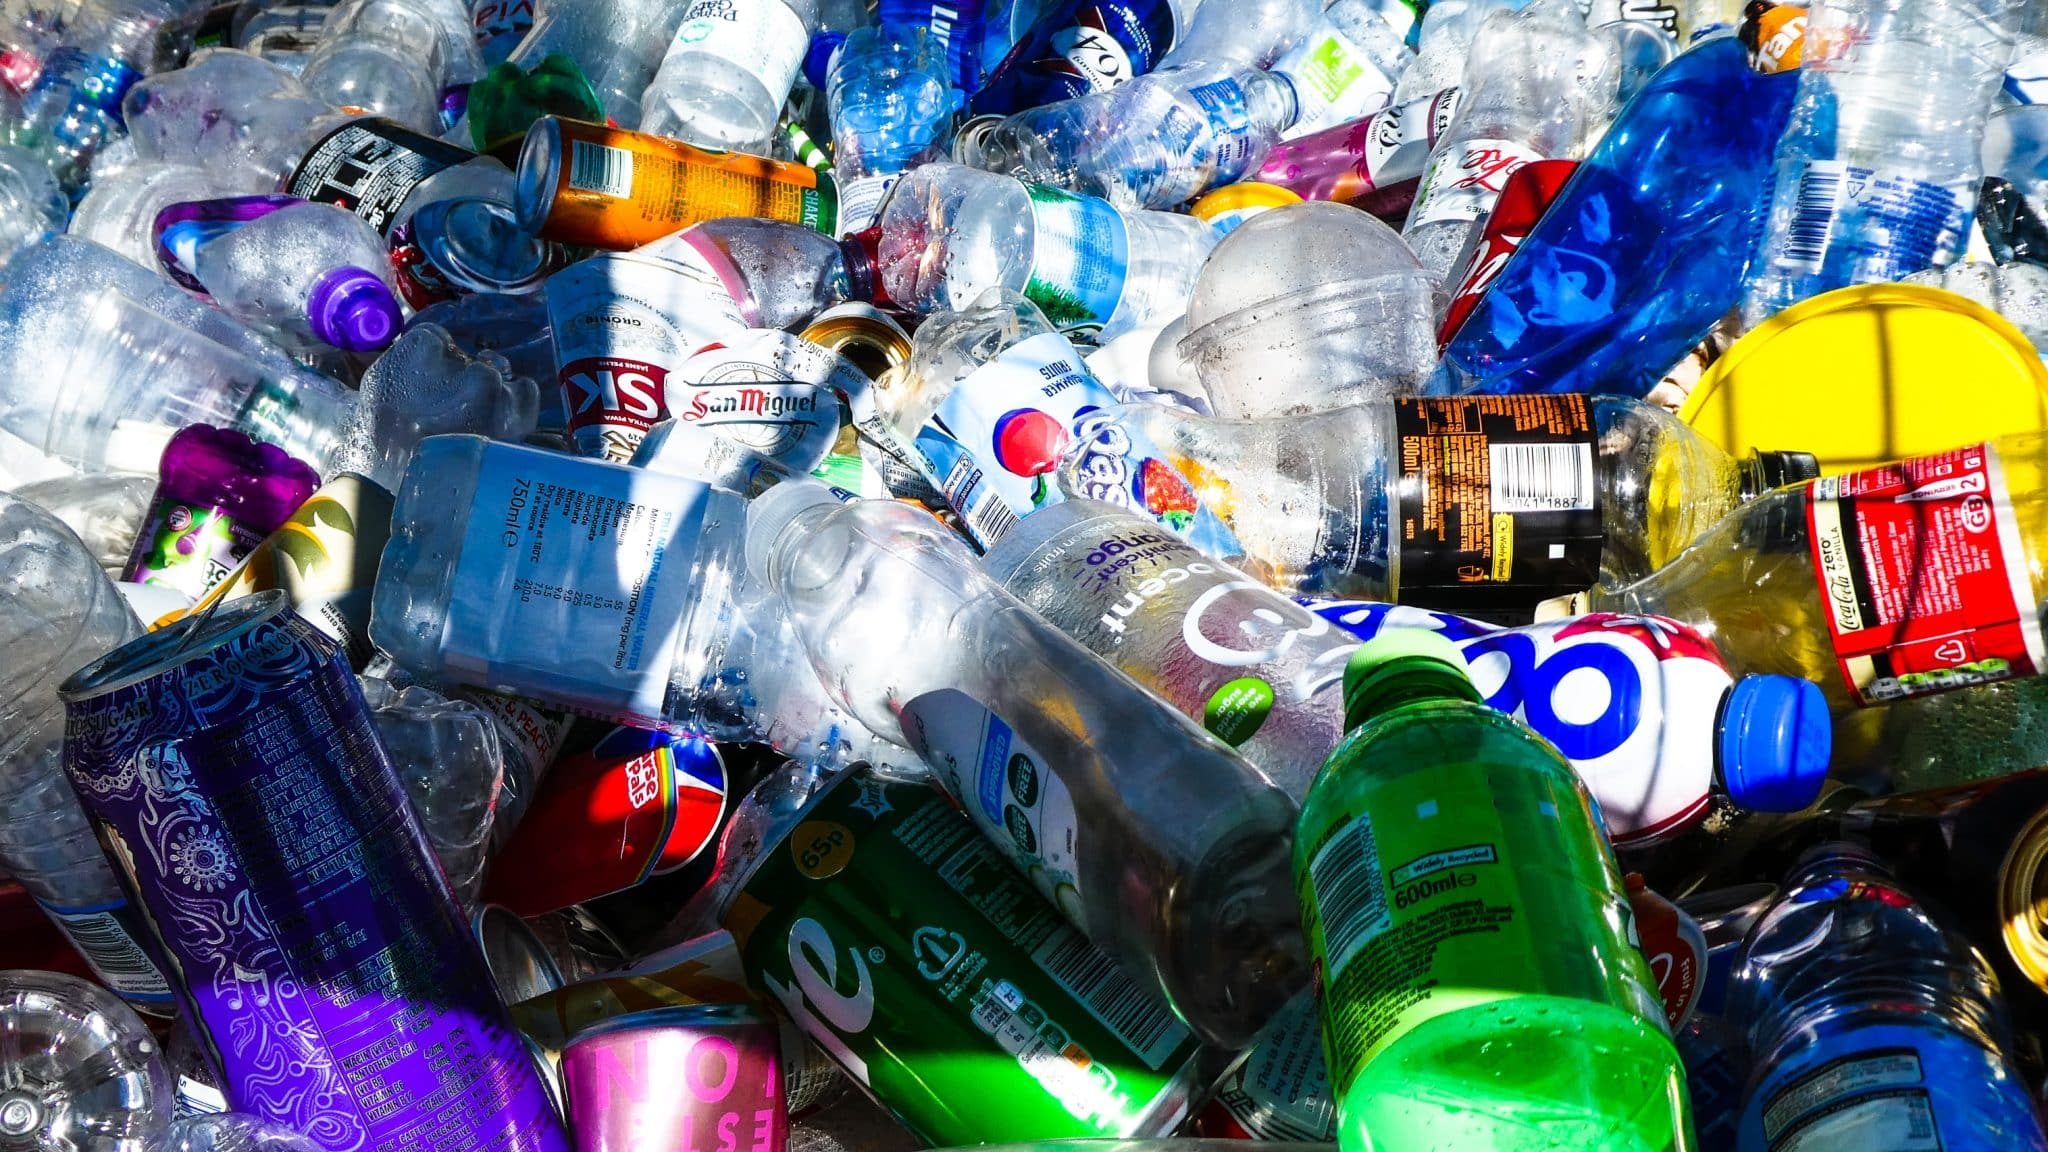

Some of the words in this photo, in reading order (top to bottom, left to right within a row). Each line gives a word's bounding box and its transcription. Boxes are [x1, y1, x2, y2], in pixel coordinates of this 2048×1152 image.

[1756, 16, 1808, 72] Tan
[801, 189, 820, 228] SHAKE
[1039, 359, 1071, 379] FRUITS
[1040, 374, 1082, 396] SUMMER
[737, 389, 816, 416] Miguel
[534, 482, 543, 494] pH
[542, 484, 554, 498] Dry
[1959, 477, 1977, 489] 2
[527, 505, 538, 530] source
[537, 499, 550, 528] residue
[562, 488, 574, 517] Nitrate
[571, 490, 584, 524] Sulphate
[580, 493, 593, 526] Chloride
[587, 495, 604, 541] Bicarbonate
[599, 497, 614, 537] Potassium
[612, 500, 623, 528] Sodium
[1966, 497, 1987, 528] GB
[647, 537, 665, 584] NATURAL
[1032, 544, 1067, 574] fruits
[1829, 526, 1847, 570] VANILLA
[324, 601, 336, 614] THE
[552, 586, 562, 599] 9.0
[563, 589, 572, 602] 9.0
[320, 607, 338, 627] MIXED
[335, 625, 351, 642] WITH
[635, 586, 653, 632] MINERAL
[627, 635, 642, 671] WATER
[181, 657, 244, 697] ZERO
[85, 694, 152, 737] SUGAR
[1211, 685, 1243, 717] sugar
[1016, 761, 1033, 801] FREE
[801, 829, 843, 869] 65p
[1393, 870, 1459, 911] 600ml
[955, 948, 982, 976] 100%
[1680, 956, 1690, 988] Fruit
[946, 955, 990, 1003] recyclable
[1004, 1024, 1017, 1036] Fat
[341, 1048, 371, 1071] NIACIN
[347, 1049, 400, 1083] PANTOTHENIC
[358, 1084, 396, 1109] VITAMIN
[364, 1097, 401, 1122] VITAMIN
